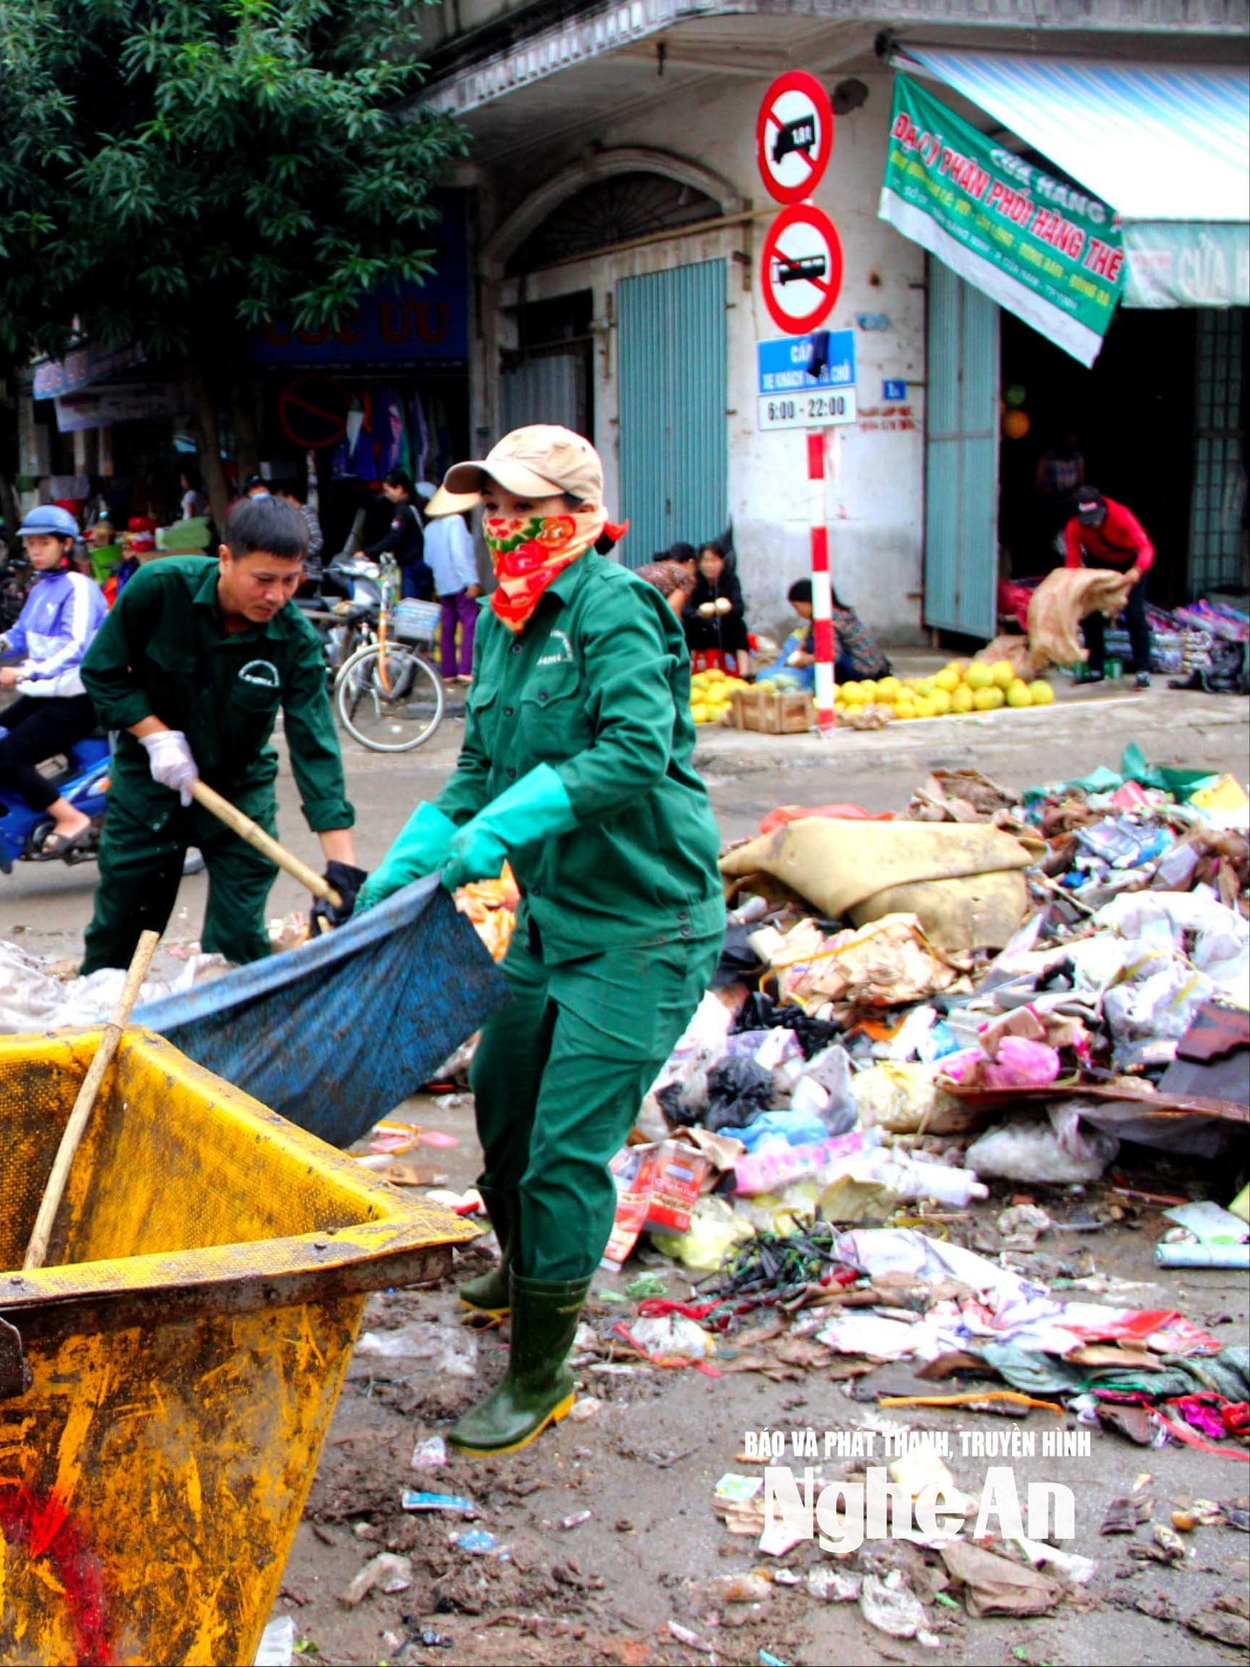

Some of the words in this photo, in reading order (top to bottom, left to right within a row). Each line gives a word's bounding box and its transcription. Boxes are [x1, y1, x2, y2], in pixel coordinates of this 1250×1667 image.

[1029, 206, 1086, 261] HÀNG
[767, 401, 795, 421] 6:00
[808, 396, 846, 418] 22:00
